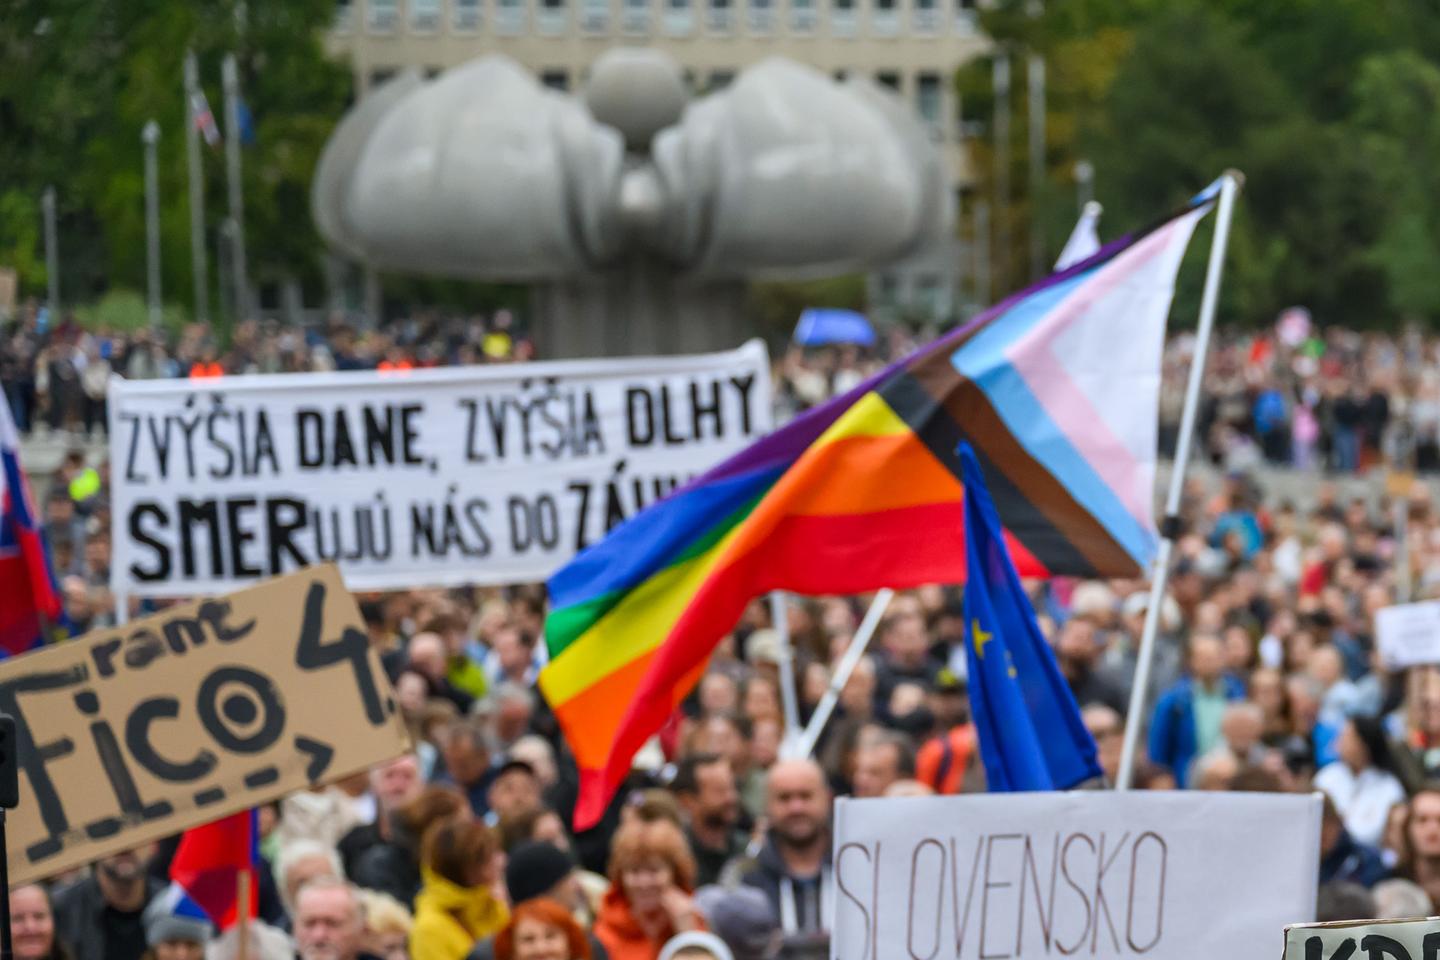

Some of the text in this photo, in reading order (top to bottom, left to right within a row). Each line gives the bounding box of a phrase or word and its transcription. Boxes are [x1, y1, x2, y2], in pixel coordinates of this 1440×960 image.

[119, 393, 280, 483] ZVÝŠIA
[295, 403, 439, 472] DANE,
[458, 376, 604, 462] ZVÝŠIA
[412, 484, 490, 557] NÁS
[508, 494, 560, 553] DO
